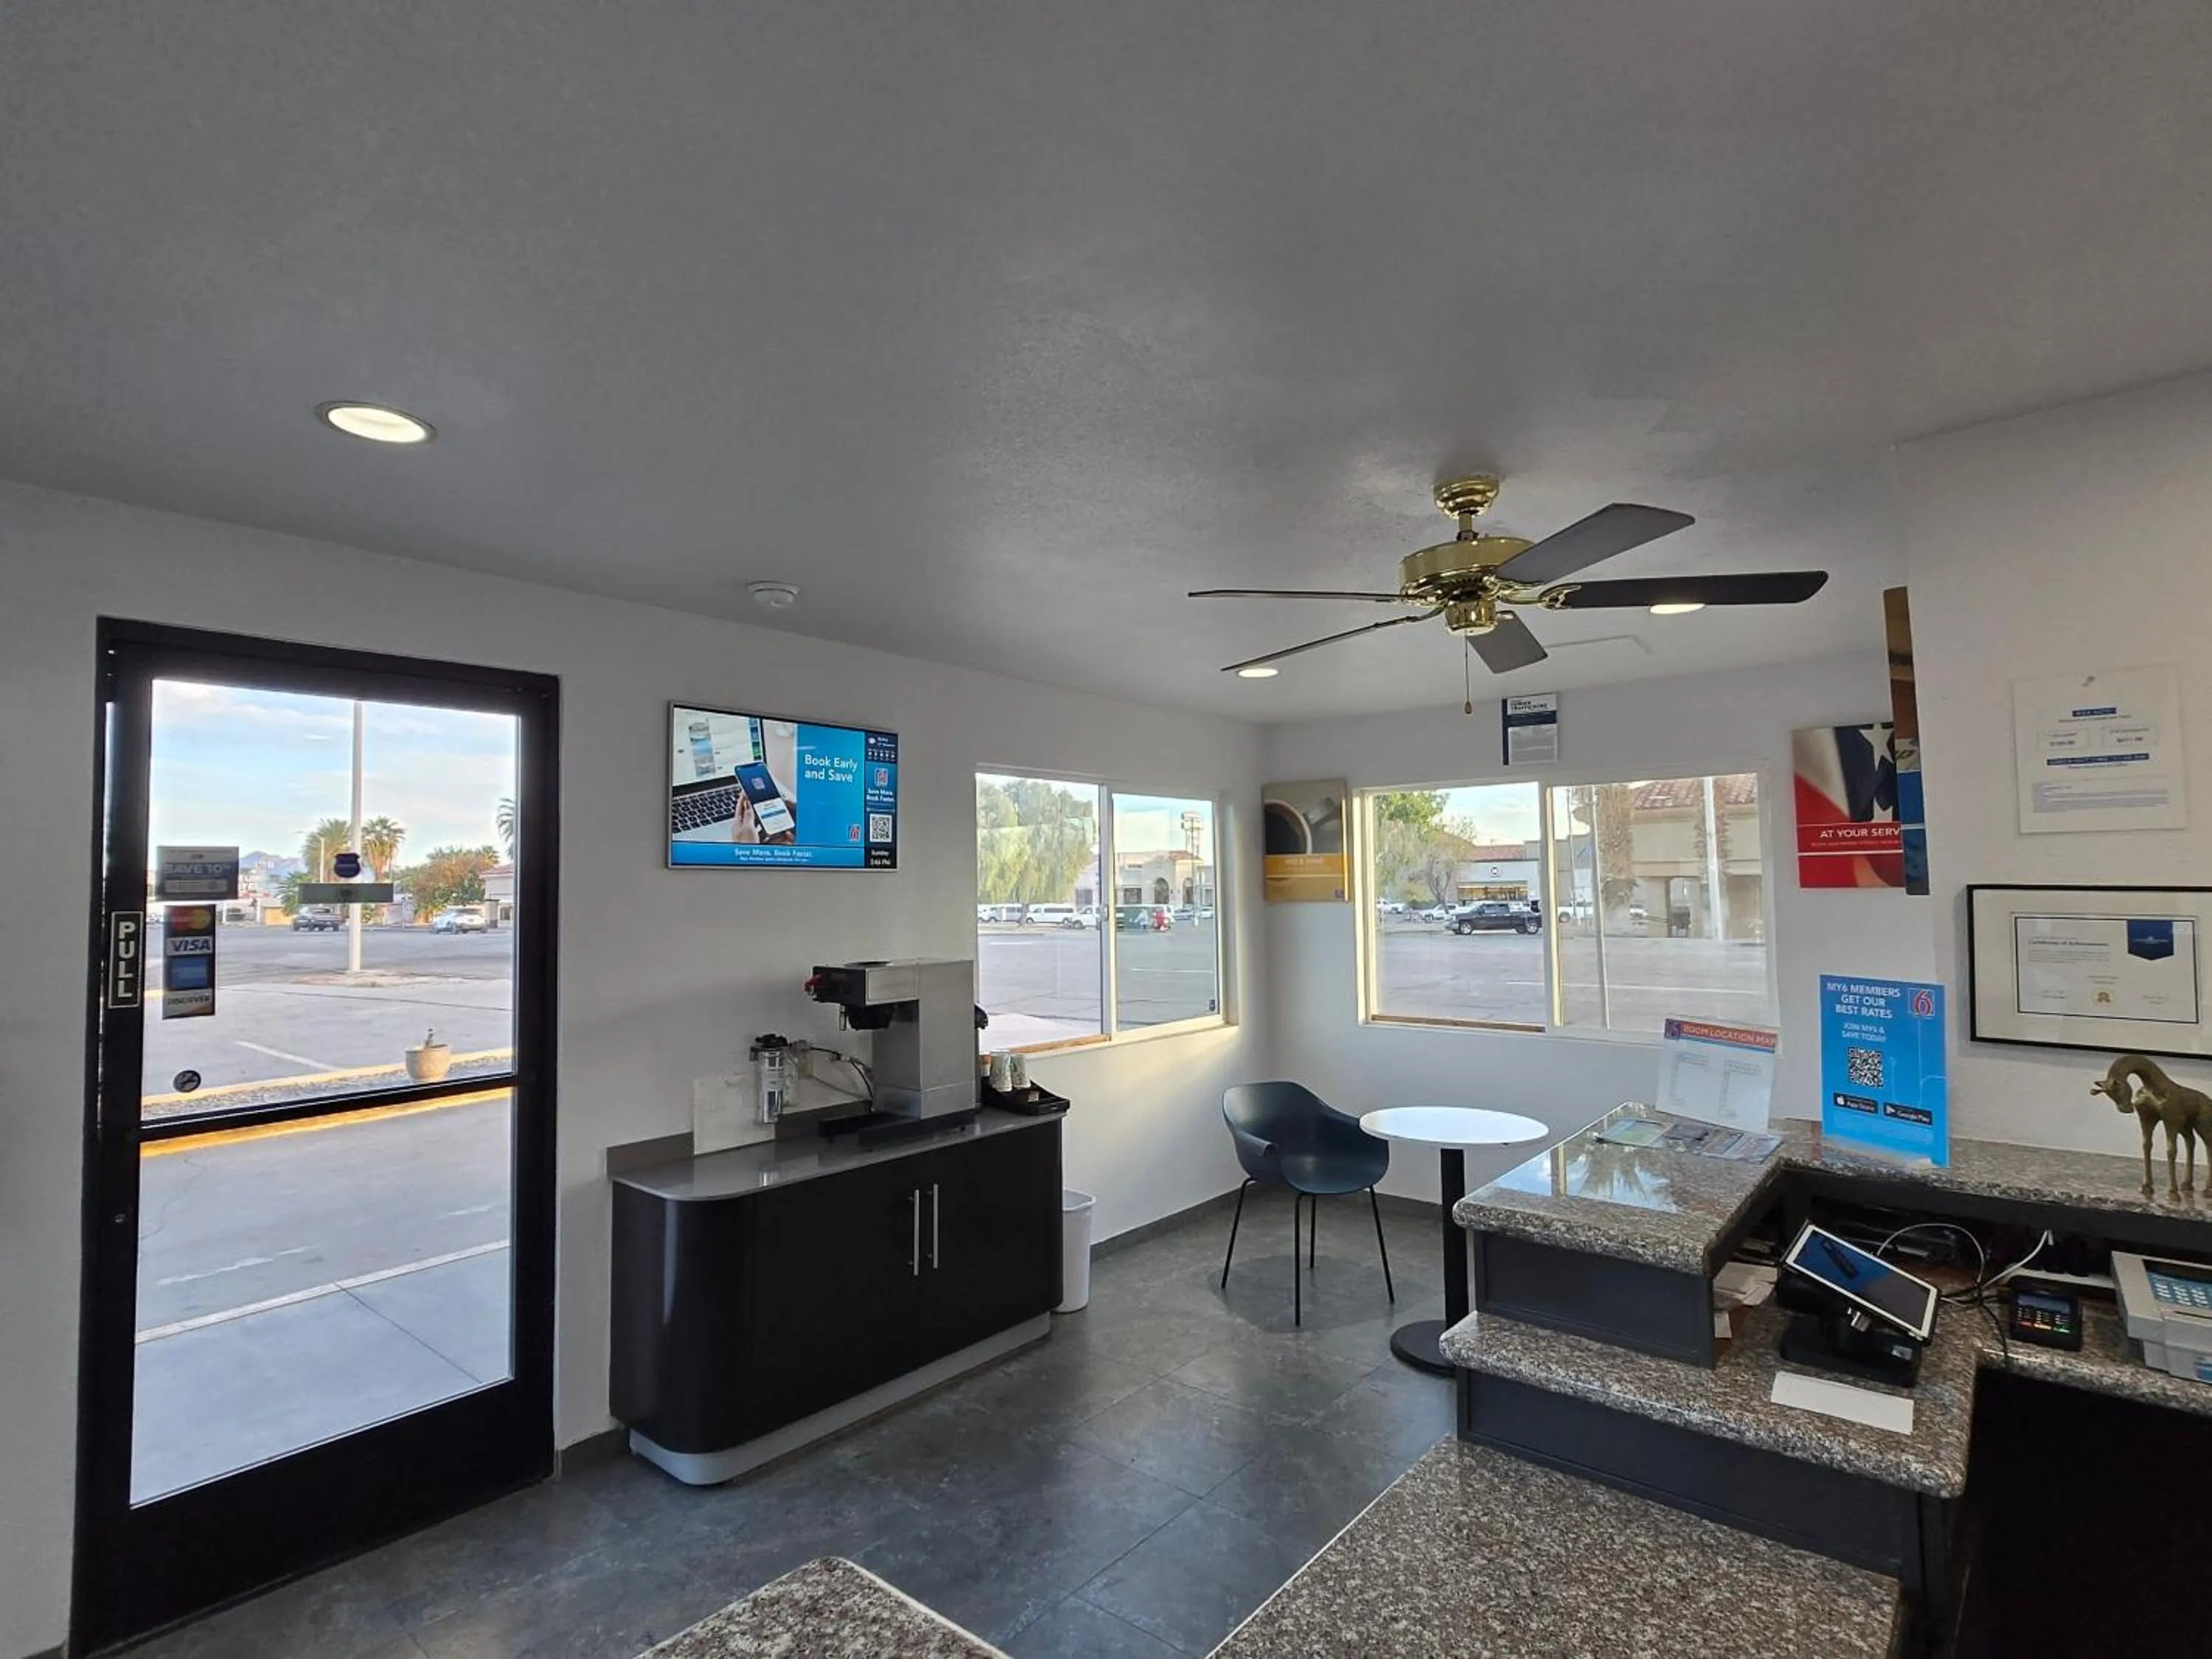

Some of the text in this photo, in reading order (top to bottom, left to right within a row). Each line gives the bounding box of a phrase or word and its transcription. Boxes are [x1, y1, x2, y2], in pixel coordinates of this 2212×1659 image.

[804, 754, 858, 773] Book Early
[804, 768, 853, 782] and Save
[1820, 827, 1901, 838] AT YOUR SERV
[171, 939, 211, 952] VISA
[118, 921, 136, 998] PULL
[1826, 982, 1901, 998] MY6 MEMBERS
[1840, 994, 1886, 1007] GET OUR
[1913, 990, 1933, 1015] 6
[1835, 1004, 1893, 1019] BEST RATES
[1683, 1024, 1708, 1034] ROOM
[1710, 1027, 1754, 1042] LOCATION
